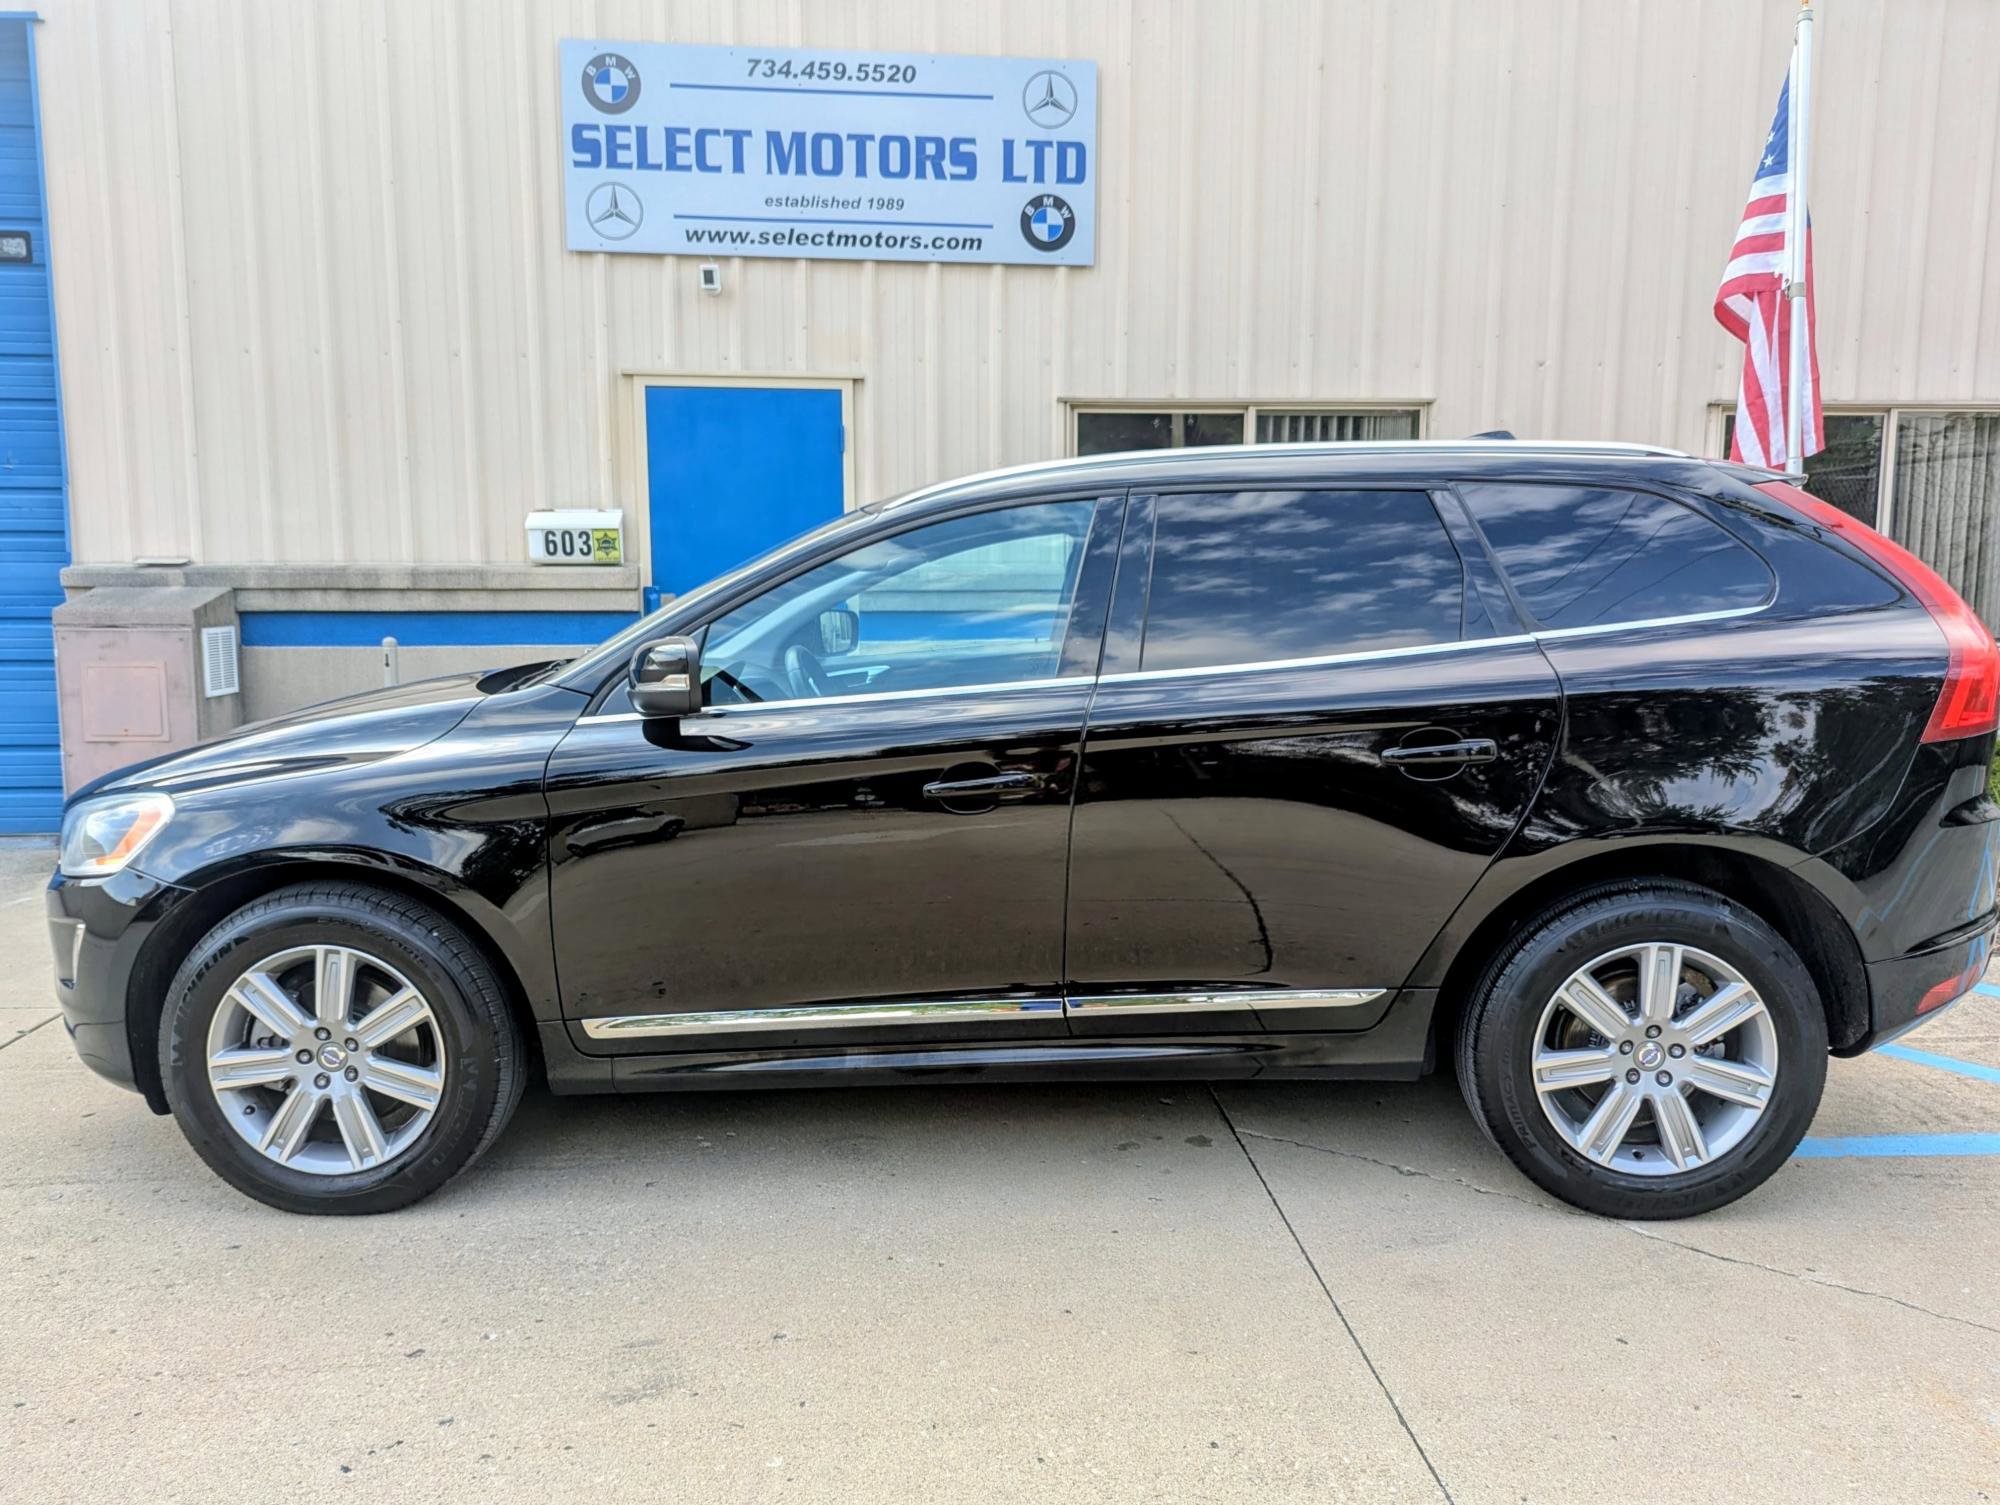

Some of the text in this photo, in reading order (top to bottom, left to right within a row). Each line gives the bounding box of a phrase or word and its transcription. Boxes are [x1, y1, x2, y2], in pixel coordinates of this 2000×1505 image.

[747, 58, 917, 84] 734.459.5520
[571, 123, 1087, 185] SELECT MOTORS LTD
[764, 195, 905, 211] established 1989
[685, 226, 983, 251] www.selectmotors.com
[544, 530, 592, 557] 603
